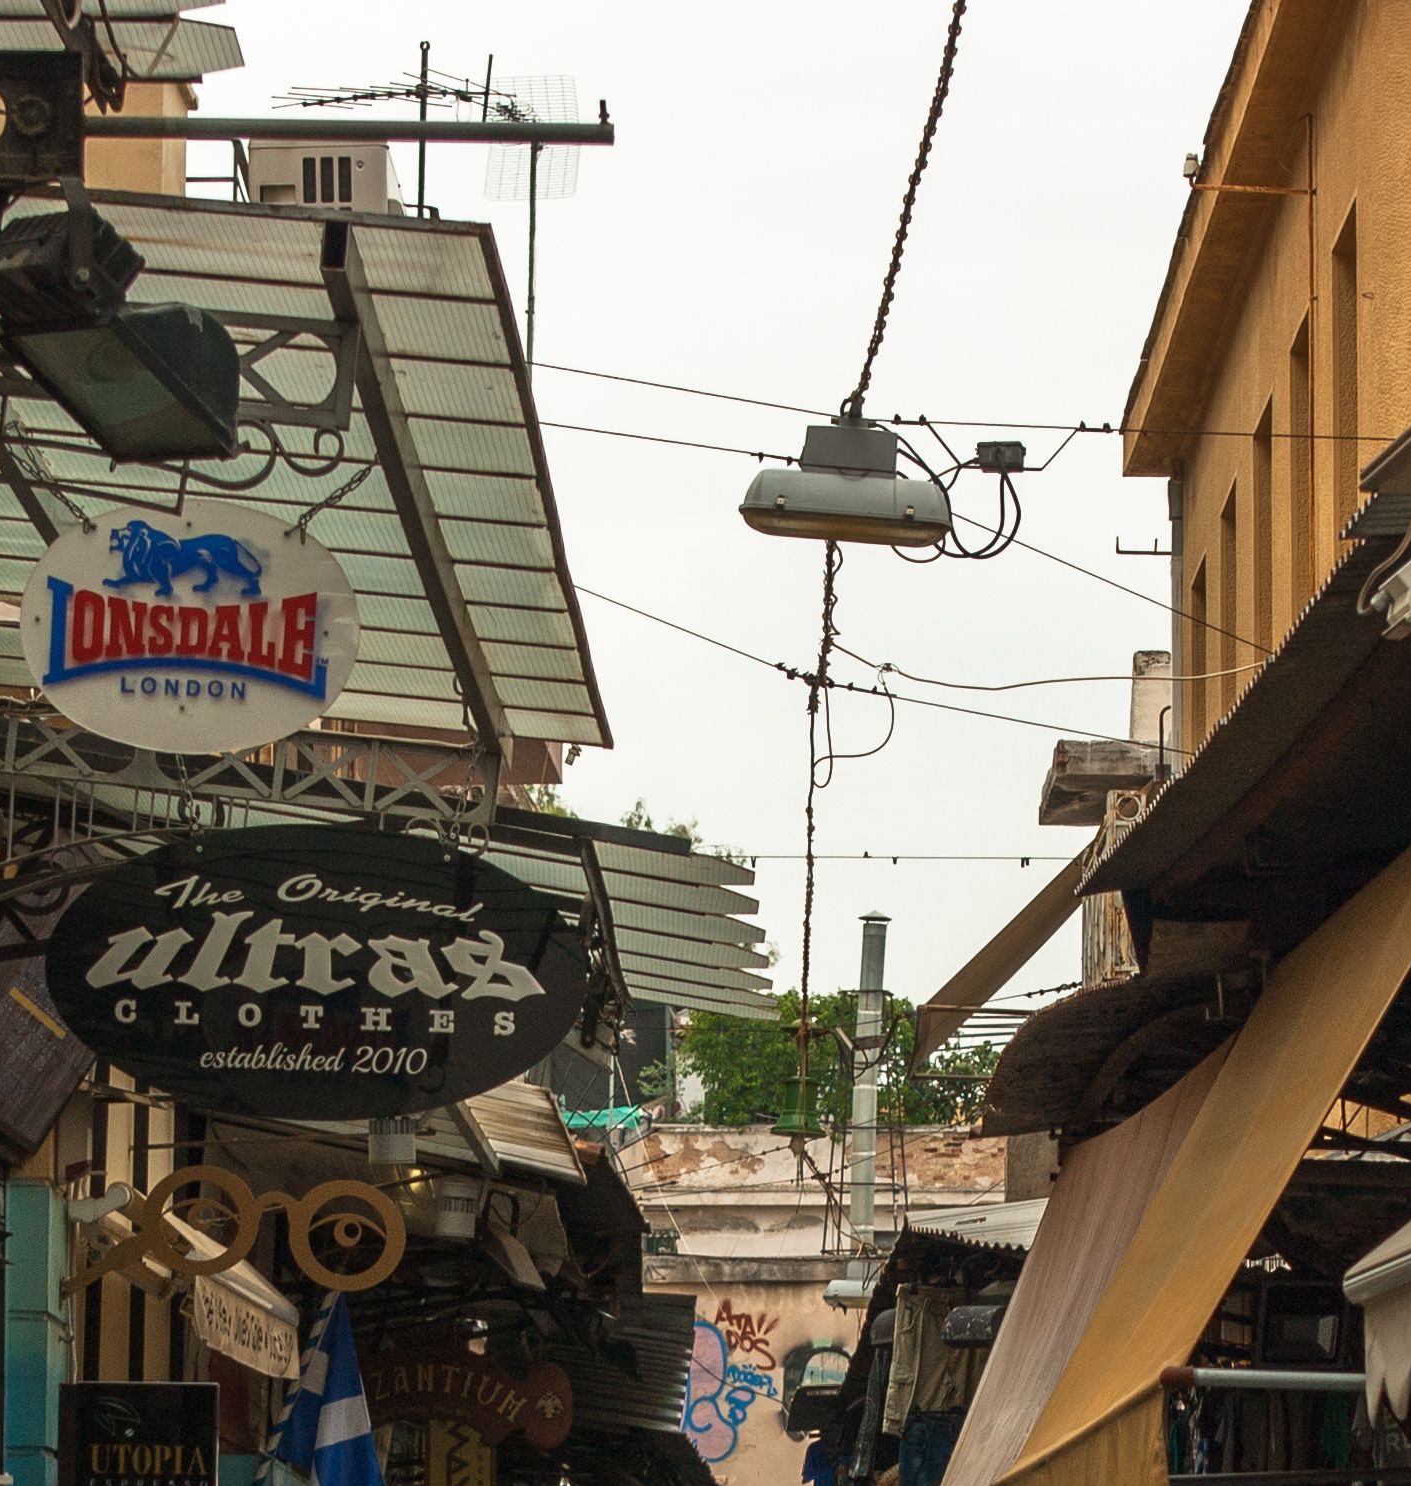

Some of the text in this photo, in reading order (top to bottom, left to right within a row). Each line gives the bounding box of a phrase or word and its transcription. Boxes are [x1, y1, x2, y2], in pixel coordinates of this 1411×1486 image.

[42, 576, 326, 701] LONSDALE
[120, 676, 247, 701] LONDON
[154, 873, 484, 922] The Original
[84, 911, 547, 1002] ultras
[114, 999, 517, 1036] CLOTHES
[199, 1046, 428, 1076] established 2010
[369, 1362, 528, 1423] ZANTIUM
[91, 1443, 207, 1475] UTOPIA
